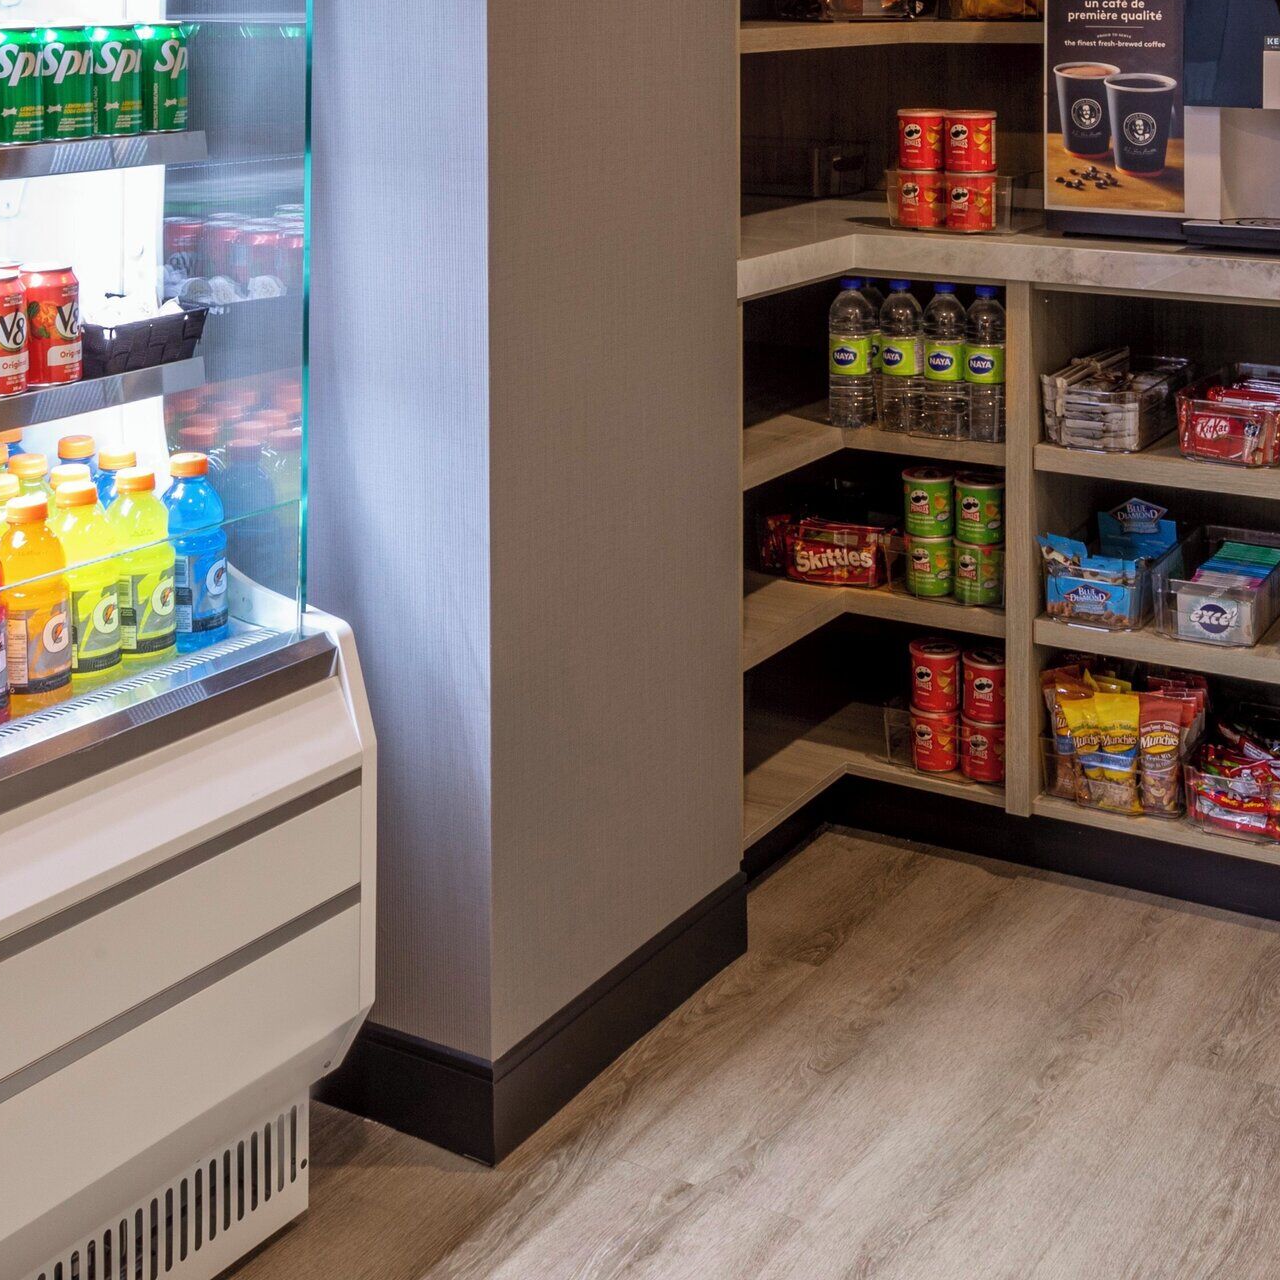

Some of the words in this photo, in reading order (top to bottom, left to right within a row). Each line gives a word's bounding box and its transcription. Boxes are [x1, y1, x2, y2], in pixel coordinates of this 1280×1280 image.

[1084, 0, 1099, 9] un
[1067, 9, 1118, 23] première
[1120, 9, 1163, 24] qualité
[1064, 39, 1076, 47] the
[1077, 39, 1097, 47] finest
[1098, 39, 1143, 48] fresh-brewed
[1143, 40, 1166, 48] coffee
[833, 351, 855, 361] NAYA
[883, 352, 901, 361] NAYA
[929, 357, 951, 366] NAYA
[969, 360, 992, 369] NAYA
[1198, 420, 1230, 439] KitKat
[1126, 503, 1147, 513] BLUE
[1117, 509, 1158, 521] DIAMOND
[796, 548, 873, 572] Skittles
[1078, 587, 1096, 596] BLUE
[1070, 593, 1106, 602] DIAMOND
[1190, 604, 1238, 627] excel
[1101, 734, 1137, 746] Munchies
[1140, 735, 1179, 748] Munchies
